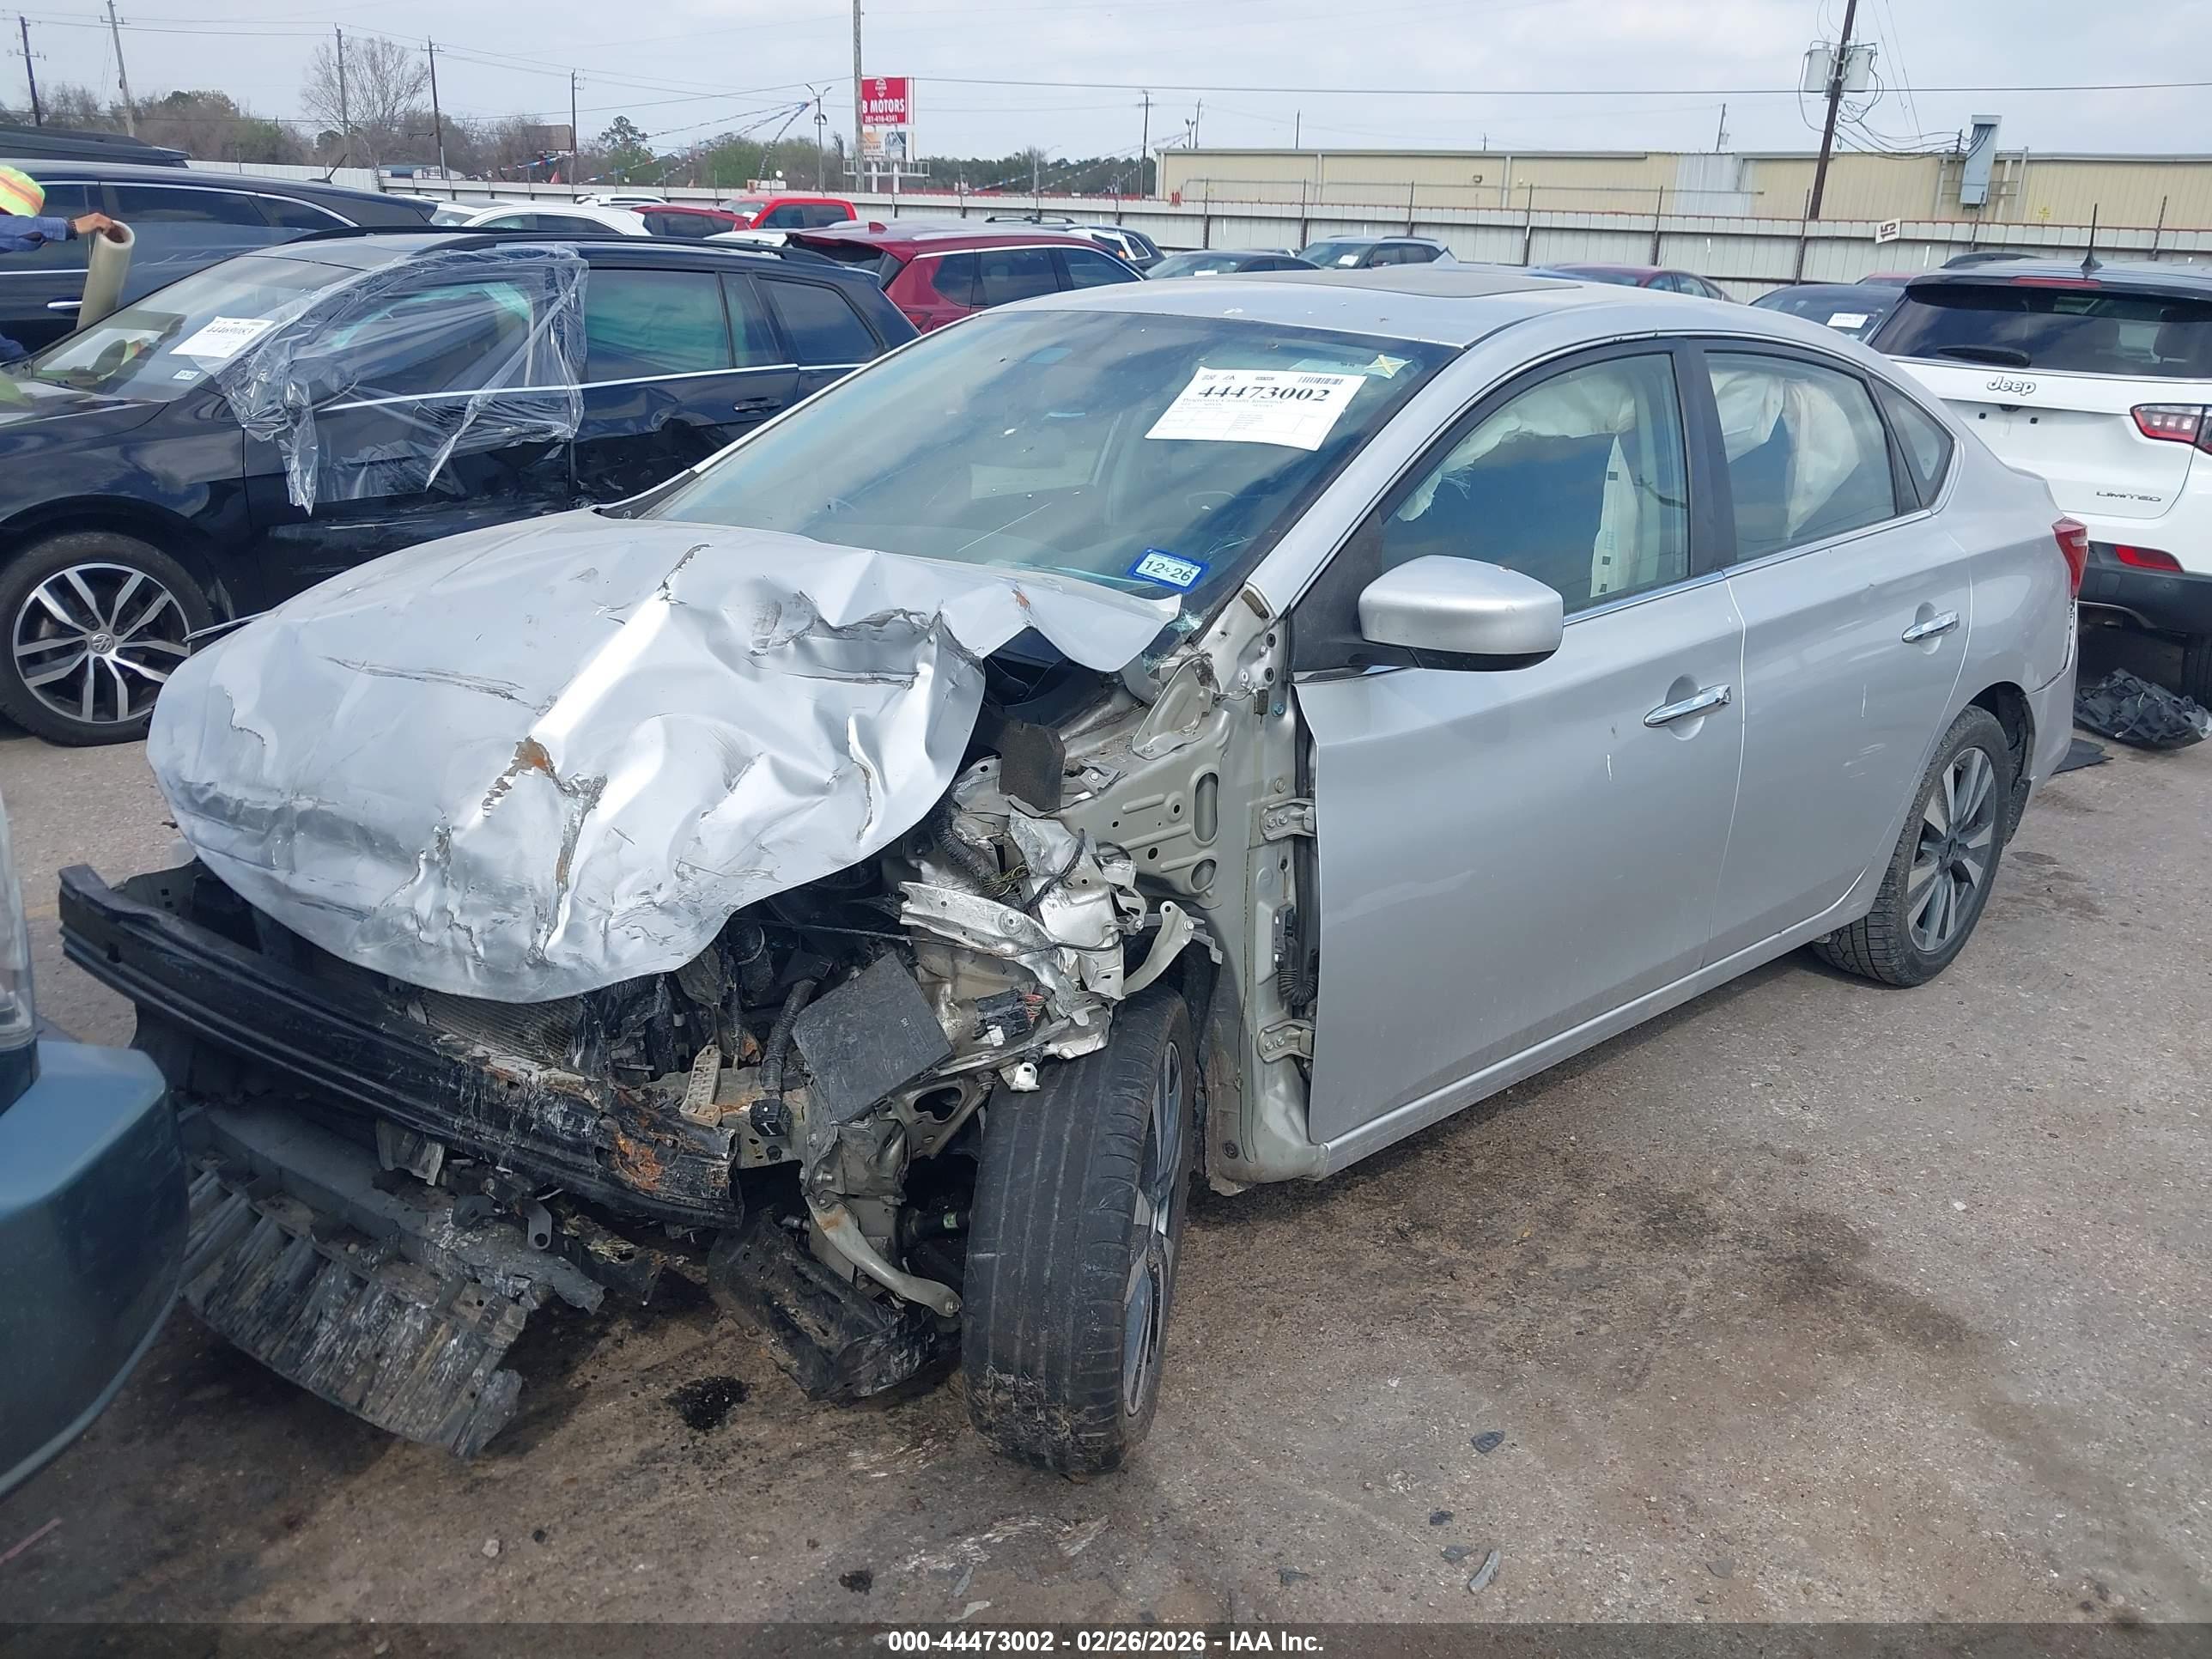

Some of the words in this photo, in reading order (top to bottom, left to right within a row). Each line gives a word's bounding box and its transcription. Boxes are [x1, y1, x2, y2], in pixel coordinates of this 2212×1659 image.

[870, 98, 905, 113] MOTORS
[1880, 222, 1897, 240] 15
[1199, 386, 1330, 402] 44473002
[1986, 376, 2036, 396] Jeep
[2096, 492, 2162, 501] LIMITED
